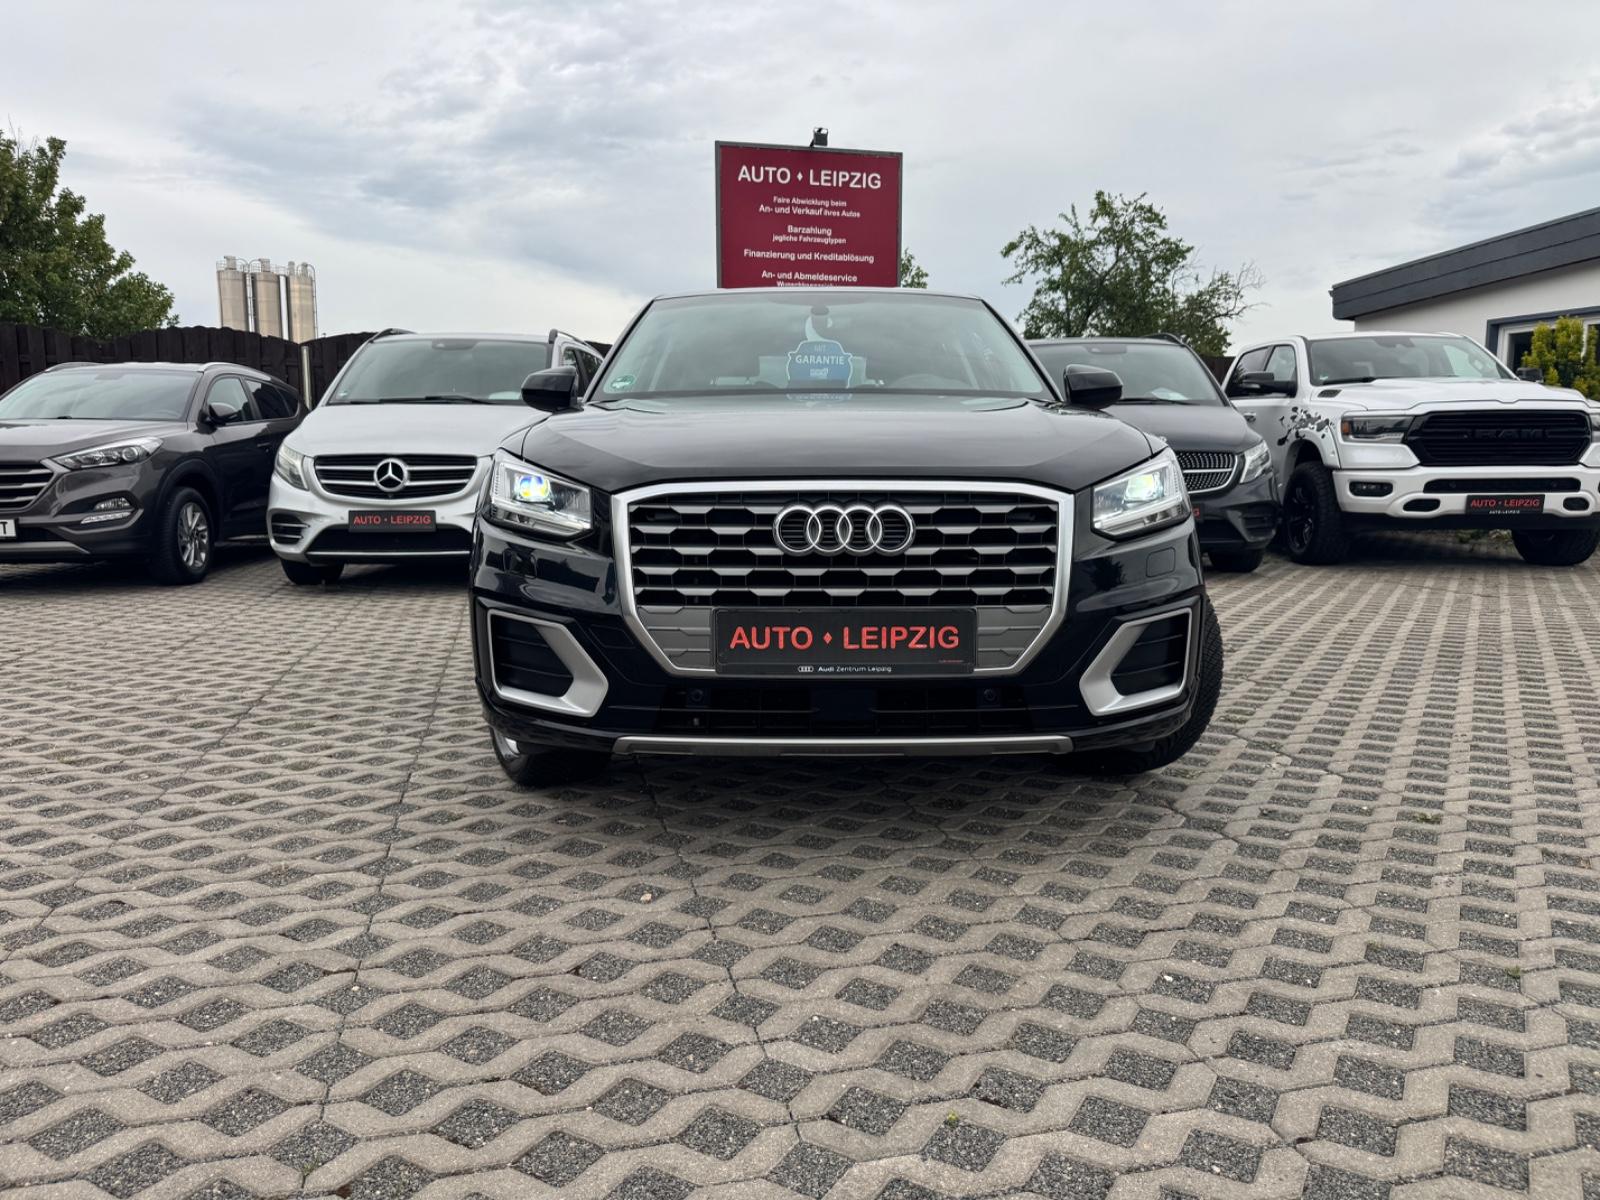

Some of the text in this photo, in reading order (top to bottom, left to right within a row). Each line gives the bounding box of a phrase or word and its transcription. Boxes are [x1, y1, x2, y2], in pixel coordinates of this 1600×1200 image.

[737, 165, 882, 189] AUTO LEIPZIG
[773, 196, 790, 204] Faire
[792, 198, 830, 207] Abwicklung
[759, 204, 773, 213] An-
[774, 206, 790, 214] und
[792, 206, 823, 216] Verkauf
[841, 210, 861, 218] Autos
[787, 225, 832, 236] Barzahlung
[772, 234, 846, 245] jegliche Fahrzeugtypen
[744, 249, 874, 264] Finanzierung und Kreditablösung
[762, 270, 776, 279] An-
[794, 272, 858, 283] Abmeldeservice
[795, 354, 845, 366] GARANTIE
[1475, 428, 1544, 439] RAM
[1471, 499, 1540, 507] AUTO LEIPZIG
[354, 515, 432, 524] AUTO LEIPZIG
[730, 626, 960, 649] AUTO LEIPZIG
